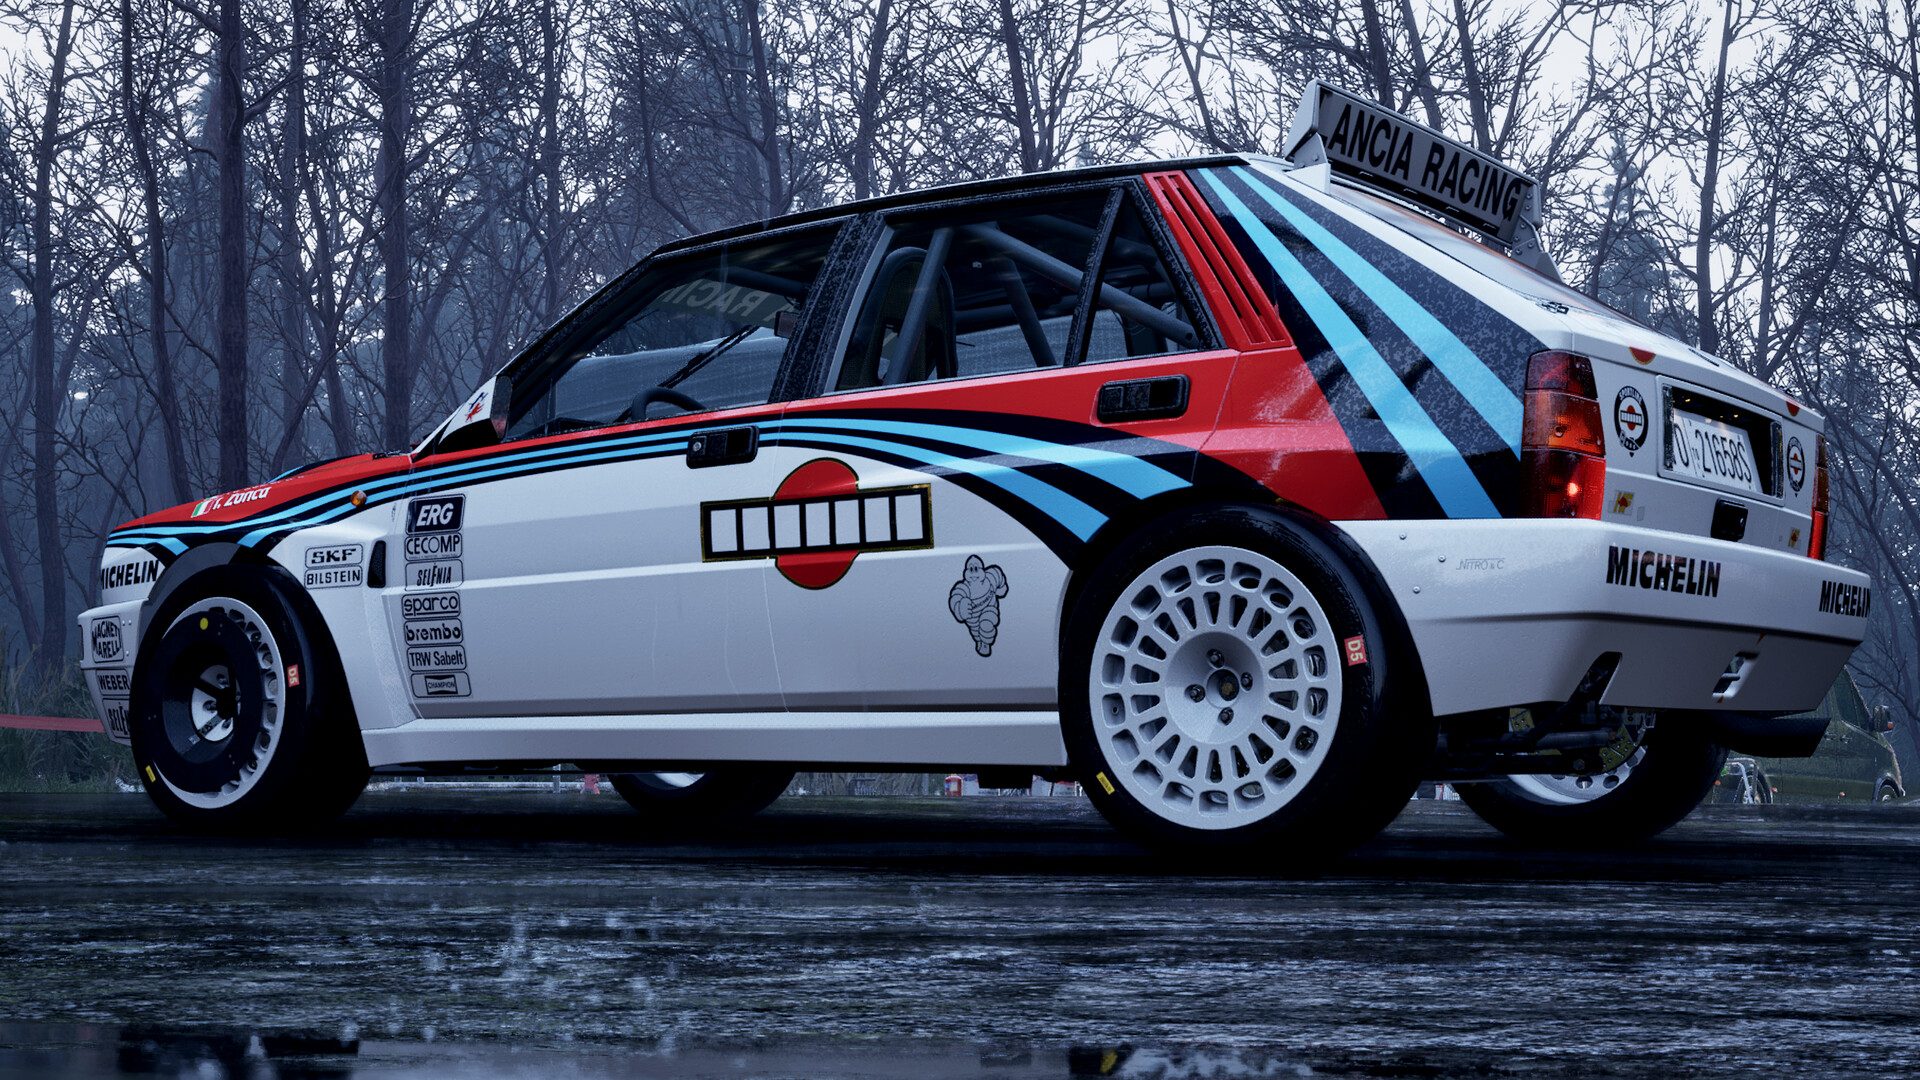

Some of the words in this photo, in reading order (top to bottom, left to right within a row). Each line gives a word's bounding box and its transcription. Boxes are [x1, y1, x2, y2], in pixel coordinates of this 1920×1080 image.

[1420, 141, 1522, 221] RACING
[416, 503, 454, 526] ERG
[406, 535, 460, 555] CECOMP
[311, 548, 356, 564] SKF
[306, 569, 360, 585] BILSTEIN
[1606, 545, 1721, 598] MICHELIN
[404, 596, 459, 616] sparco
[405, 622, 461, 641] brembo
[409, 651, 431, 667] TRW
[433, 650, 463, 666] Sabelt
[1348, 639, 1364, 662] D5
[99, 674, 130, 690] WEBER
